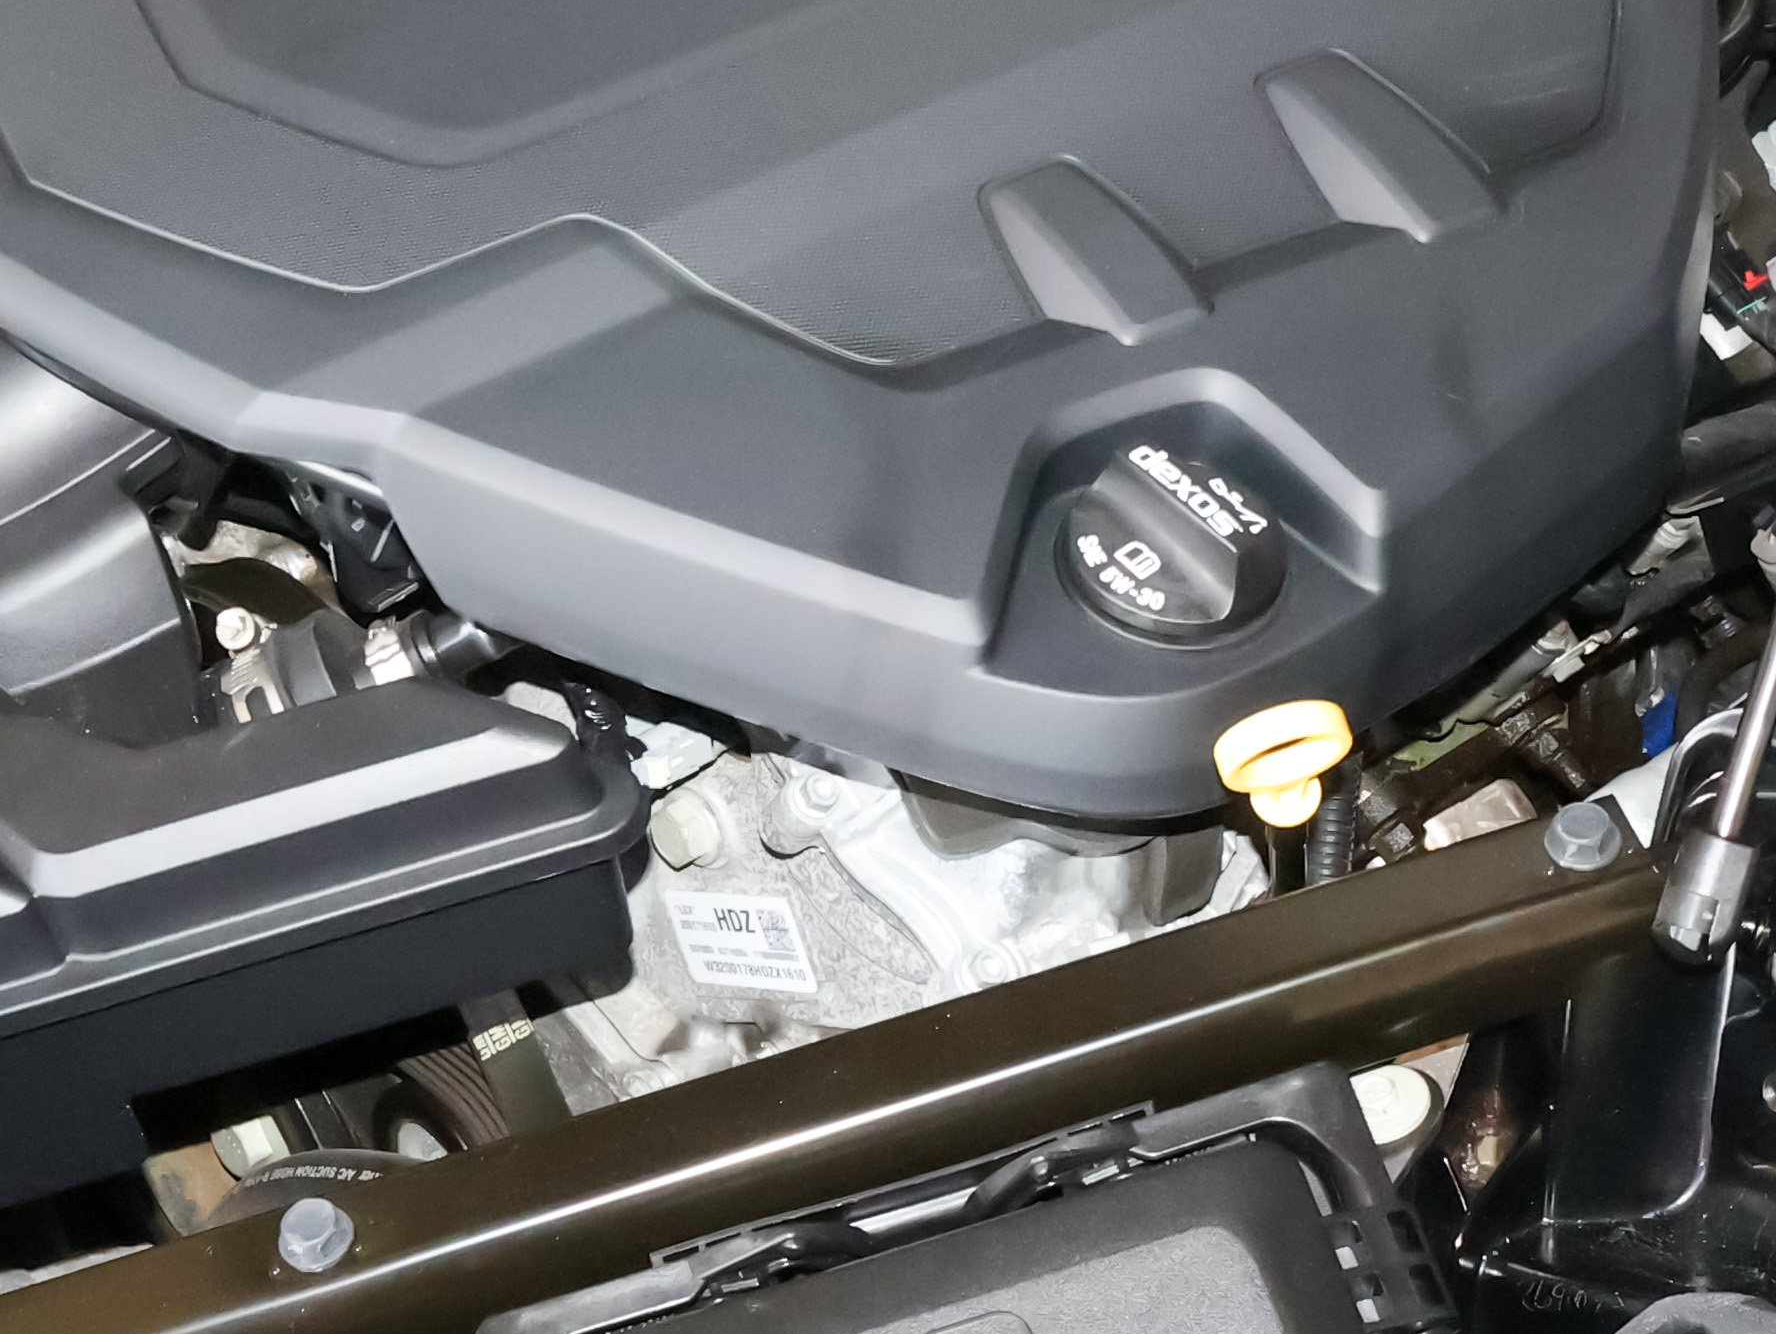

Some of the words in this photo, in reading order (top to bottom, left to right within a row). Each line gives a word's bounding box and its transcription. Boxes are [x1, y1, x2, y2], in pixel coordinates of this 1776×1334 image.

[1128, 444, 1244, 537] dexos
[1099, 565, 1166, 611] 5W-30
[713, 907, 756, 933] HDZ
[294, 1165, 337, 1180] SUCTION
